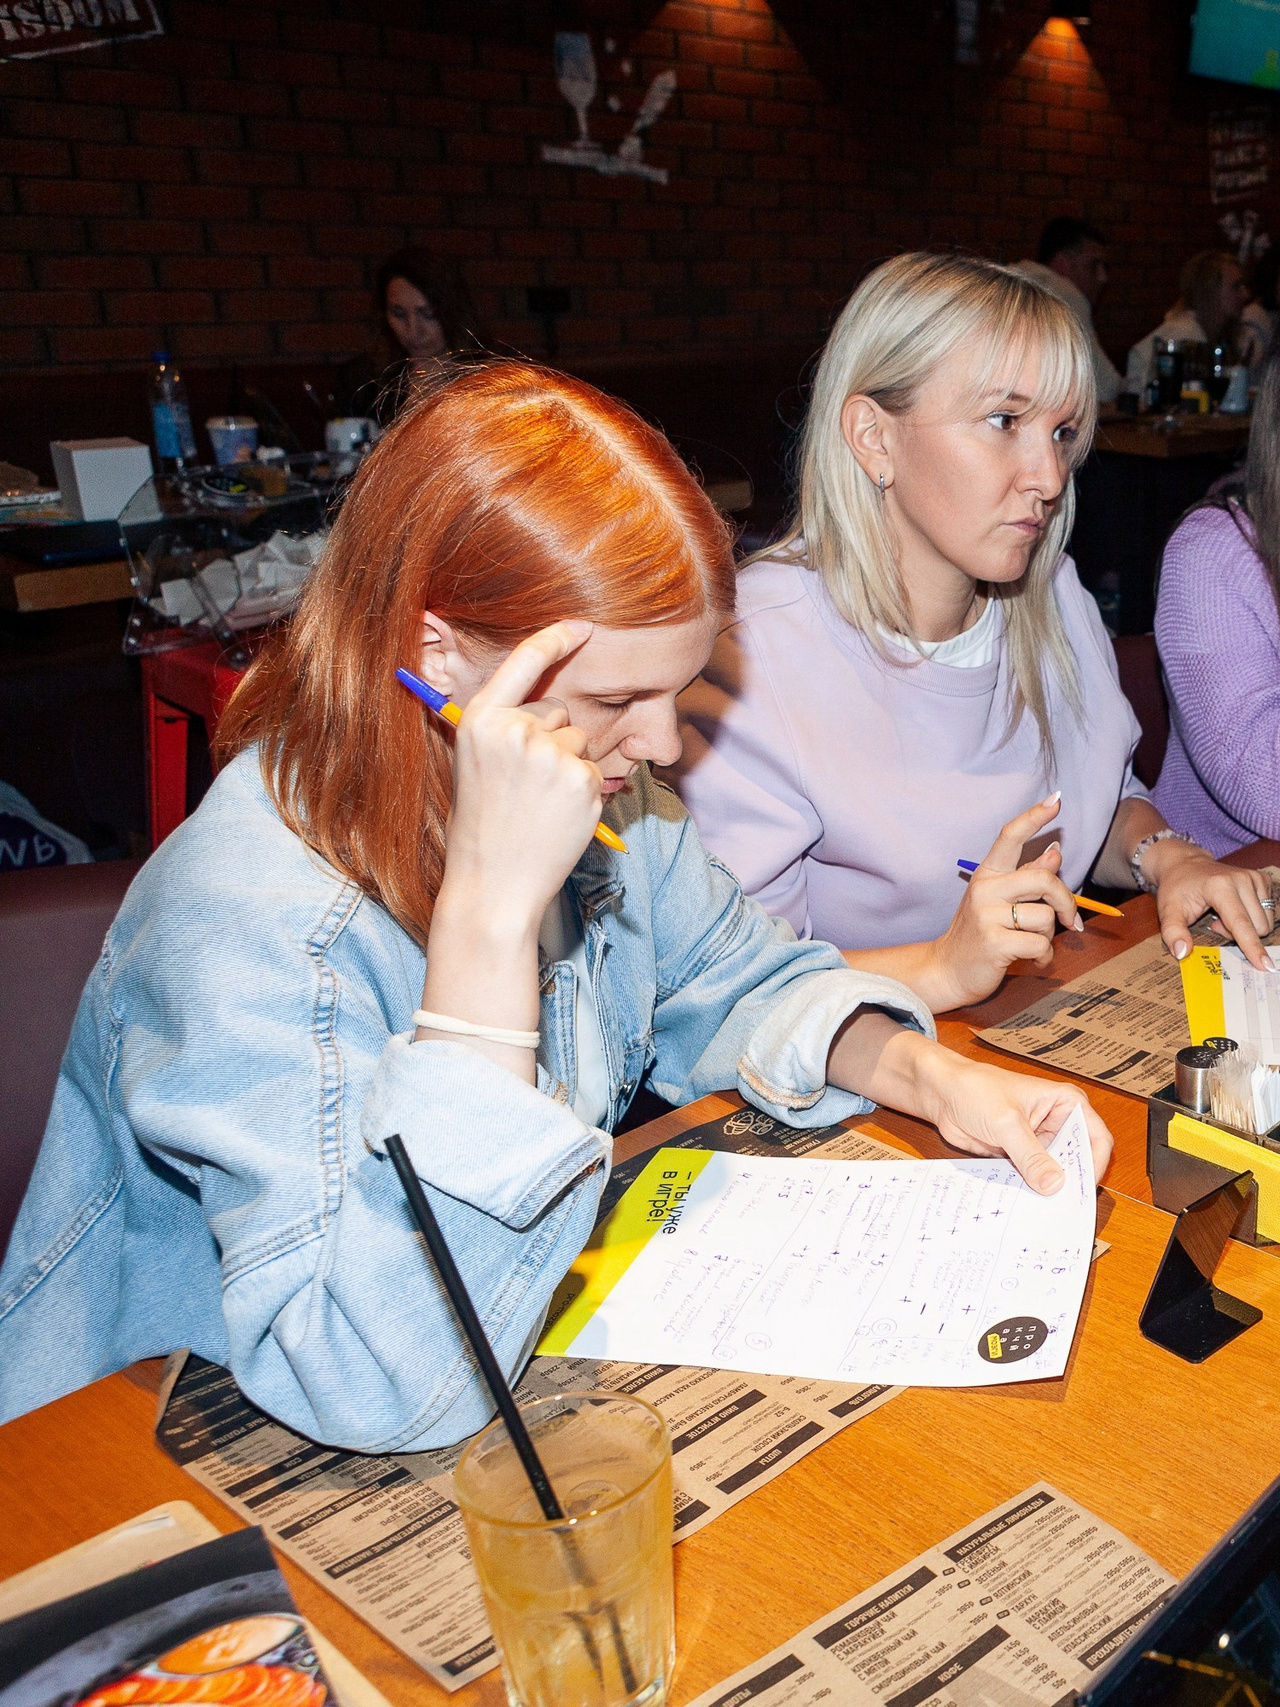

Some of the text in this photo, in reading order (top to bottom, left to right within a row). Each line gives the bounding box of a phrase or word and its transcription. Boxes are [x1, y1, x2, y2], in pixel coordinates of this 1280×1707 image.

[646, 1171, 678, 1222] в игре!
[663, 1184, 691, 1235] ты уже
[621, 1368, 664, 1393] ВИНО БЕЛОЕ
[651, 1391, 676, 1407] МАССИ
[720, 1404, 739, 1419] ВИНО
[685, 1415, 723, 1441] ИГРИСТОЕ
[770, 1414, 807, 1443] СКОЛЬЗКИЙ
[751, 1438, 773, 1453] СОСОК
[758, 1448, 782, 1465] ШОТЫ
[412, 1486, 432, 1499] RICH
[419, 1490, 439, 1504] RICH
[300, 1505, 334, 1527] МОРСЫ
[400, 1501, 421, 1514] КОЛА
[406, 1496, 445, 1520] RICH КОЛА
[416, 1516, 463, 1549] АССИЧЕСКИЙ
[956, 1498, 1045, 1556] НАТУРАЛЬНЫЕ ЛИМОНАДЫ
[993, 1570, 1033, 1600] ЯЛТИНСКИЙ
[844, 1584, 915, 1631] ГОРЯЧИЕ НАПИТКИ
[1011, 1593, 1038, 1614] ТАРХУН
[830, 1621, 882, 1655] РОМАШКОВЫЙ
[882, 1612, 898, 1624] ЧАЙ
[1048, 1602, 1100, 1642] АПЕЛЬСИНОВЫЙ
[1062, 1616, 1113, 1654] КЛАССИЧЕСКИЙ
[850, 1640, 902, 1675] КЛЮКВЕННЫЙ
[902, 1629, 919, 1643] ЧАЙ
[864, 1658, 891, 1678] МЯТОЙ
[871, 1653, 931, 1695] СМОРОДИНОВЫЙ
[930, 1641, 948, 1655] ЧАЙ
[937, 1662, 964, 1684] КОФЕ
[1052, 1678, 1067, 1690] 50р
